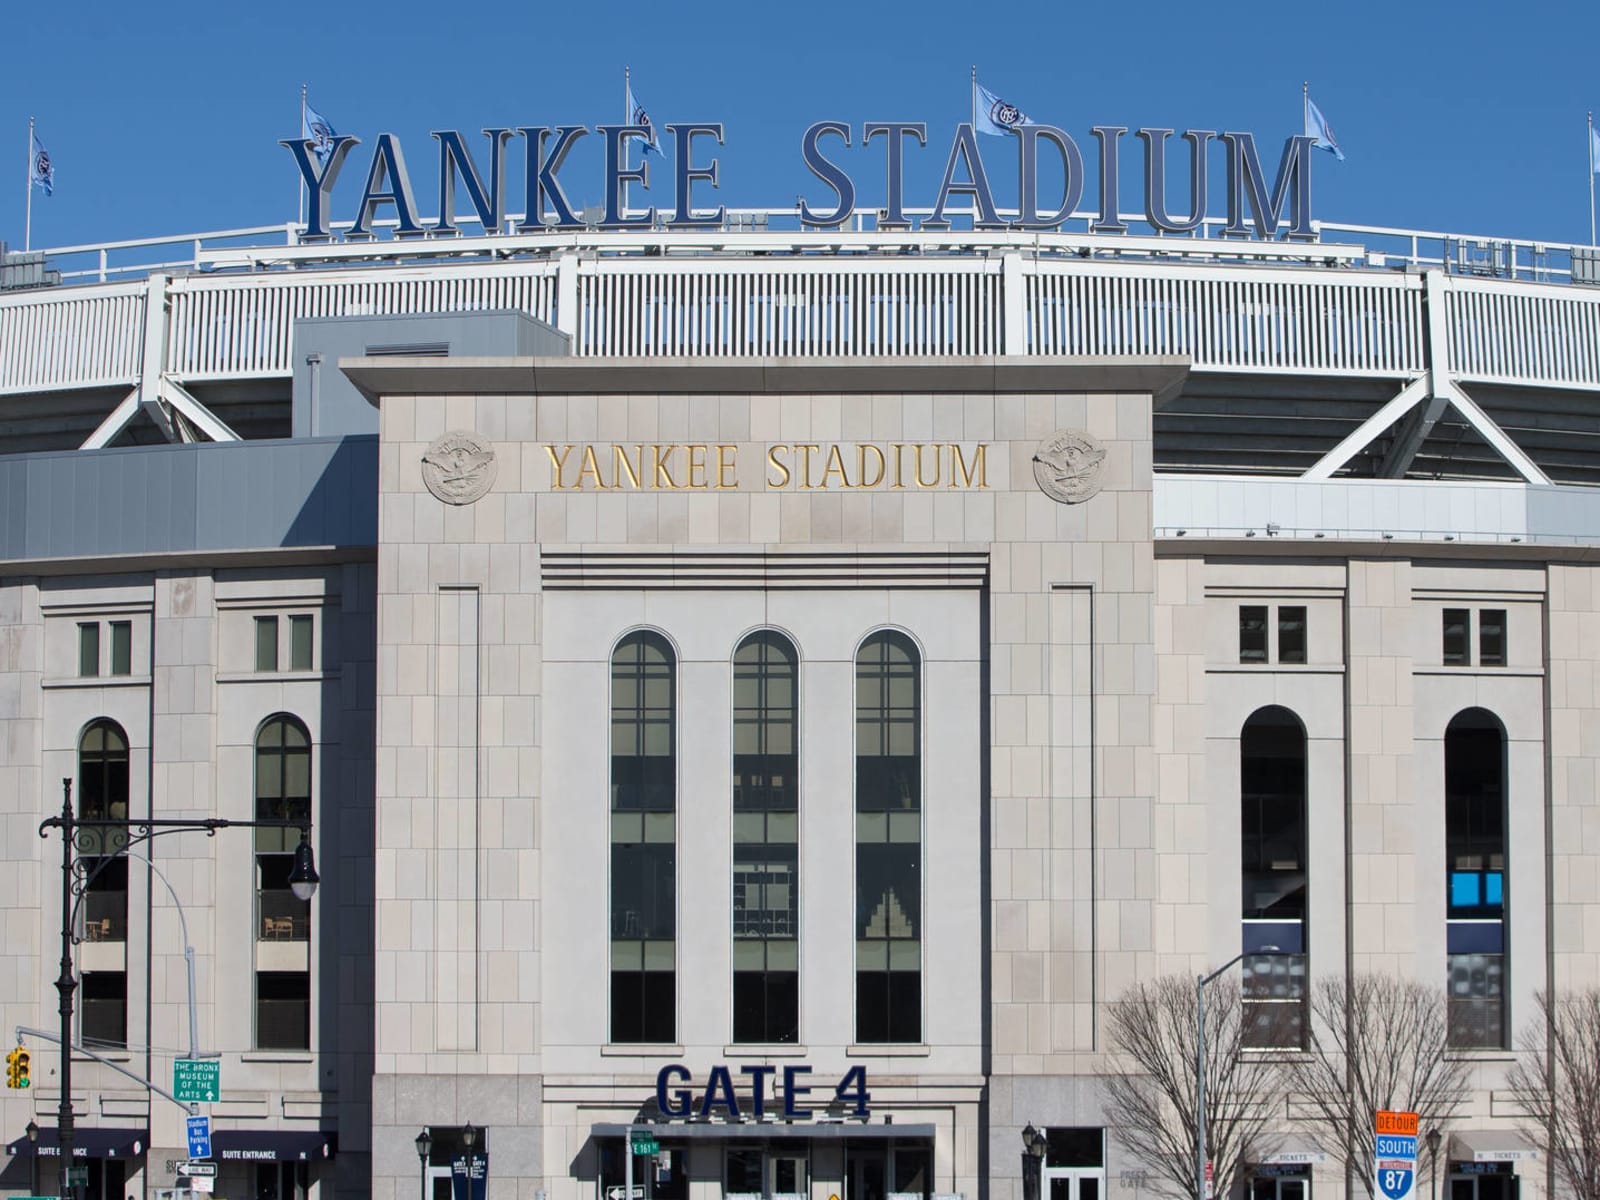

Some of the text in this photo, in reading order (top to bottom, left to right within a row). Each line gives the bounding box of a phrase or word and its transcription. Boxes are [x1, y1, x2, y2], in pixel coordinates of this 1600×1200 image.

[278, 121, 1319, 239] YANKEE STADIUM
[542, 444, 740, 489] YANKEE
[767, 444, 991, 489] STADIUM
[175, 1063, 218, 1072] THE BRONX
[179, 1072, 214, 1080] MUSEUM
[196, 1081, 212, 1089] THE
[655, 1064, 871, 1118] GATE 4
[1380, 1116, 1415, 1130] DETOUR
[38, 1147, 55, 1156] SUITE
[633, 1144, 638, 1154] E
[640, 1144, 651, 1154] 161
[1379, 1140, 1415, 1154] SOUTH
[222, 1150, 276, 1159] SUITE ENTRANCE
[1385, 1170, 1406, 1190] 87
